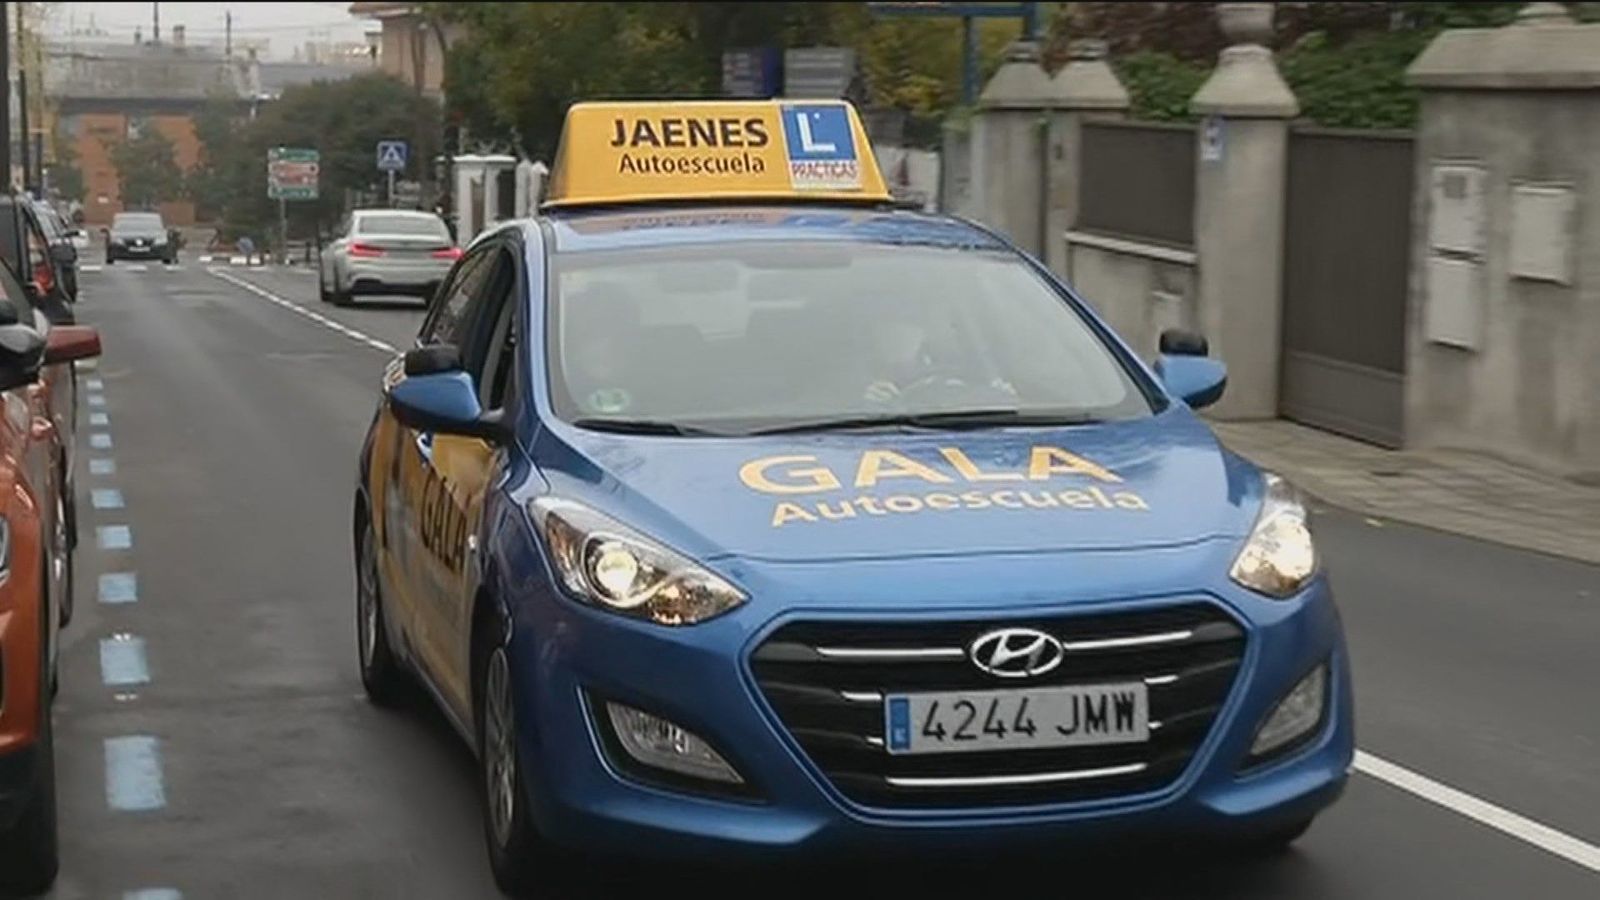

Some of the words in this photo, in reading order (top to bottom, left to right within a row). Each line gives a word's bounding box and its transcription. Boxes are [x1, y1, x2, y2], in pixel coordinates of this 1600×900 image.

[611, 117, 769, 148] JAENES
[796, 112, 836, 152] L
[619, 152, 766, 175] Autoescuela
[738, 443, 1125, 495] GALA
[420, 466, 466, 575] GALA
[770, 485, 1150, 529] Autoescuela
[921, 697, 1037, 741] 4244
[1056, 691, 1136, 736] JMW
